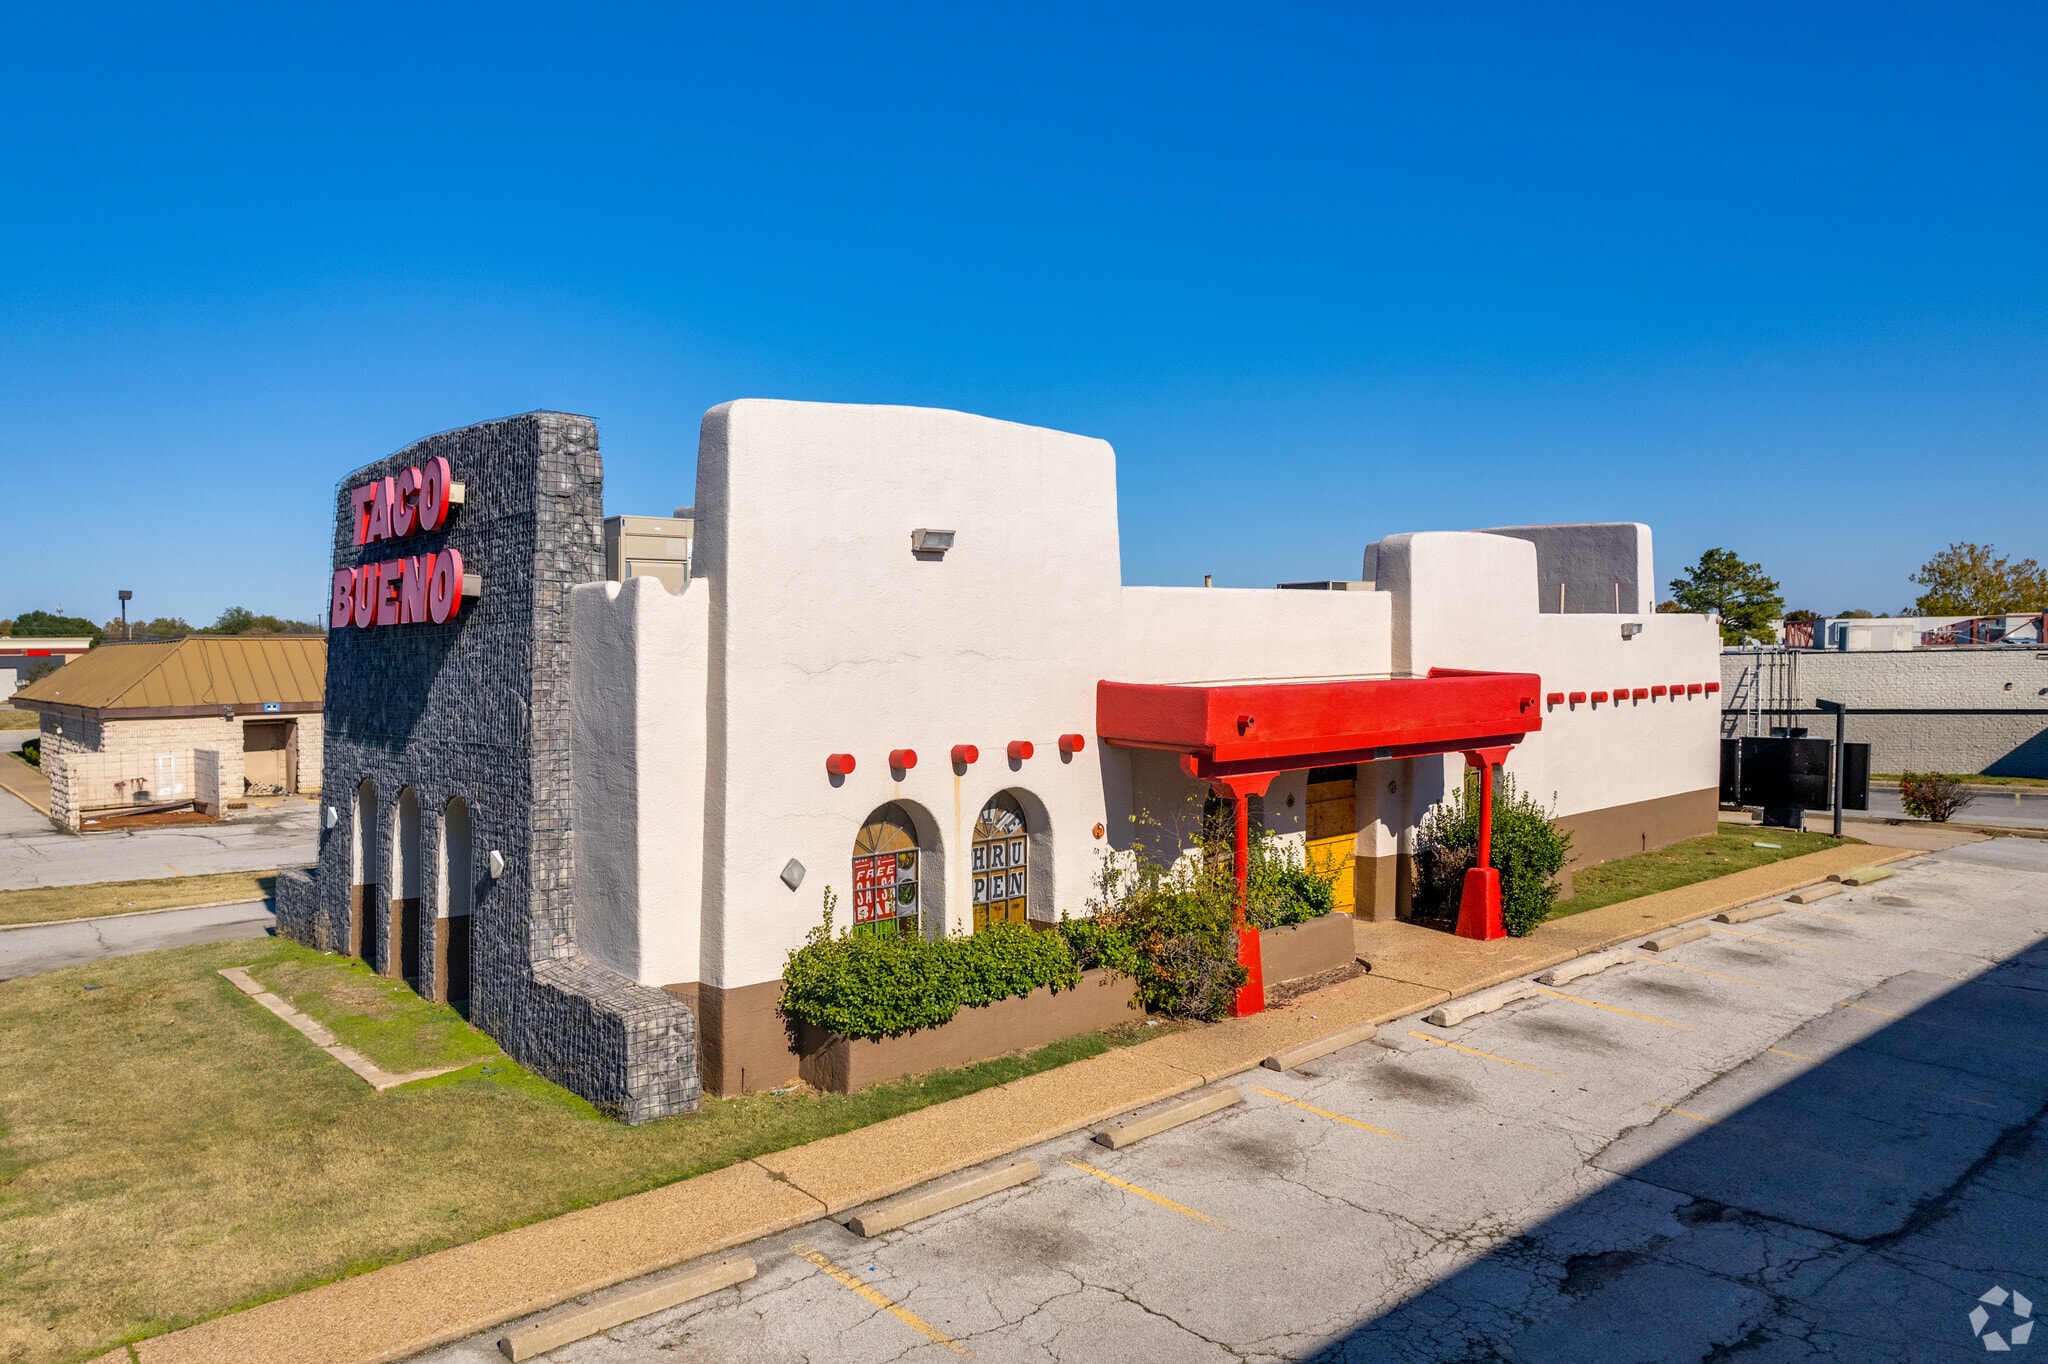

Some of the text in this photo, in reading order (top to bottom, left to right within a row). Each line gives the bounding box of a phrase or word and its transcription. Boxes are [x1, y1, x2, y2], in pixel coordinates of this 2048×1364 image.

[351, 456, 451, 546] TACO
[332, 548, 464, 628] BUENO
[856, 864, 896, 881] FREE
